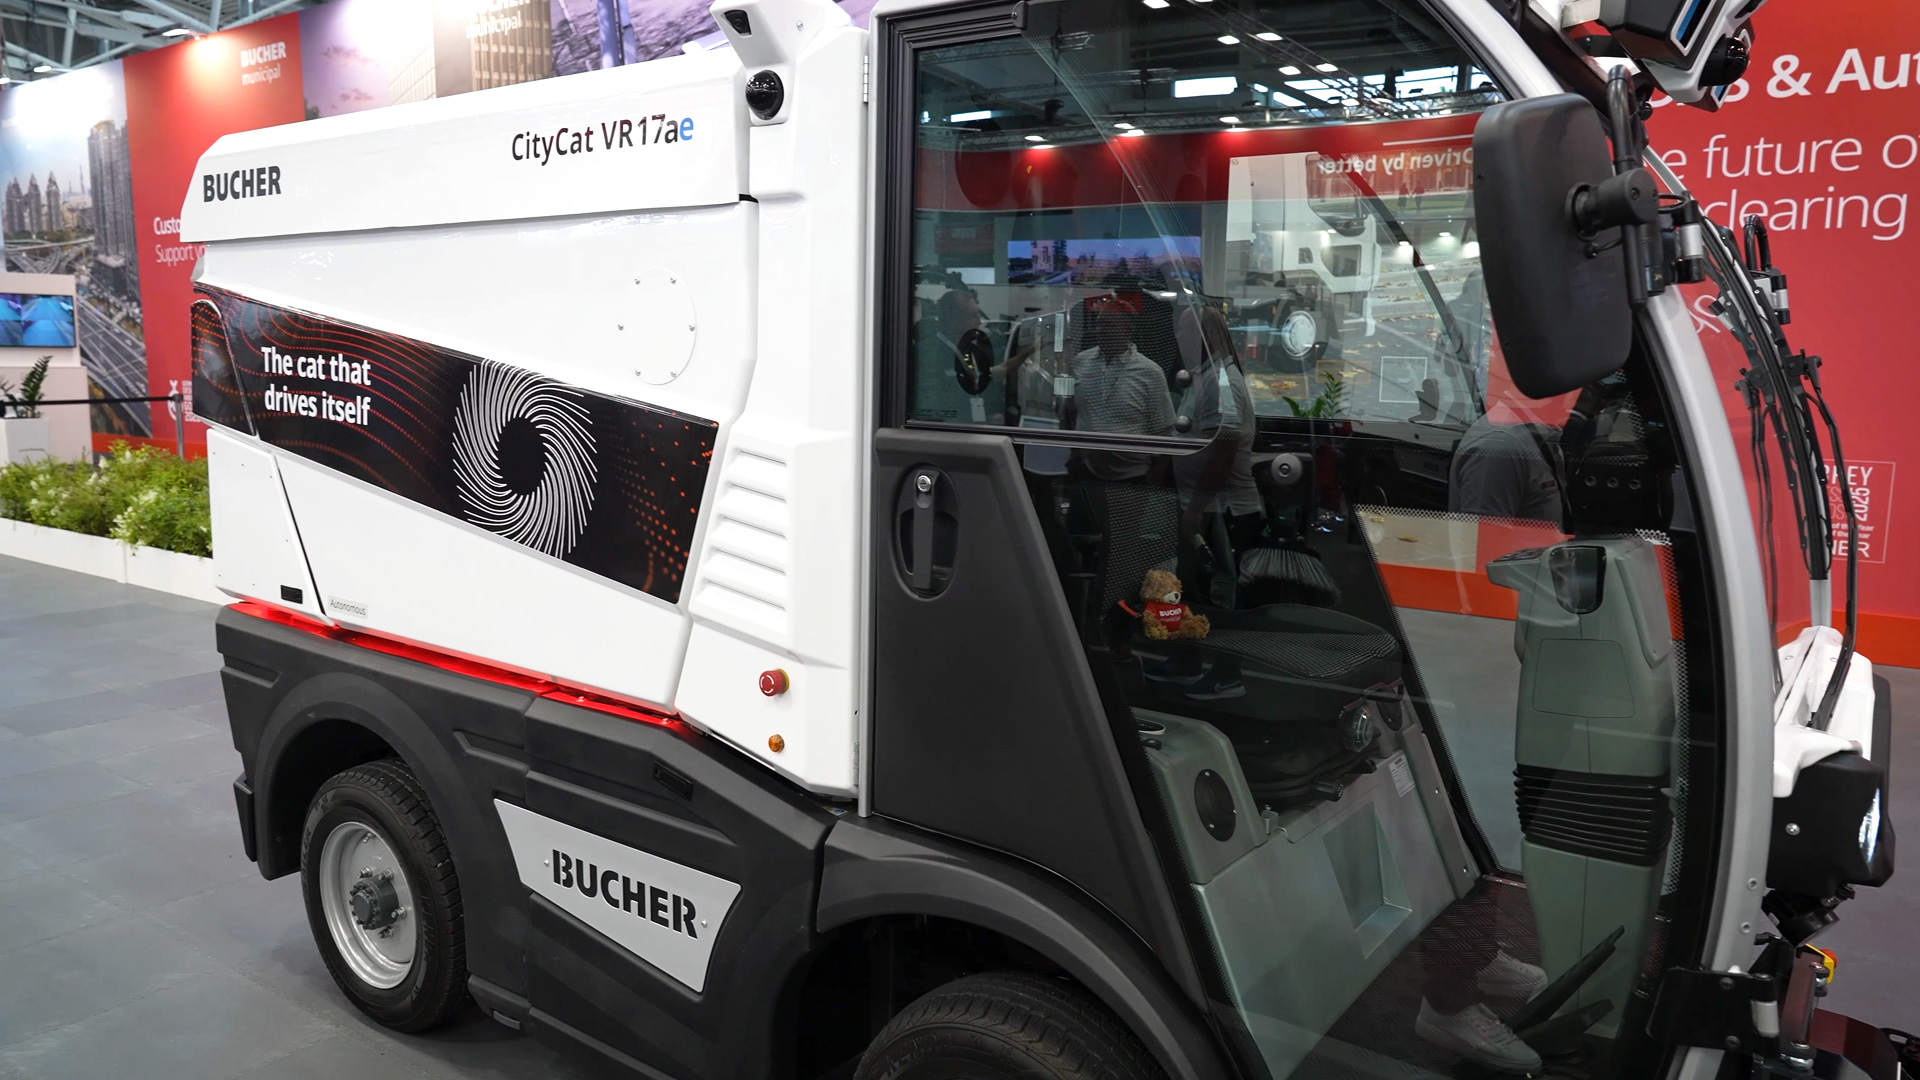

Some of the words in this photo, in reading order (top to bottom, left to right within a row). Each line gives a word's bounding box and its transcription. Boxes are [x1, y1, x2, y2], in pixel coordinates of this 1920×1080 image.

[241, 41, 287, 67] BUCHER
[242, 63, 281, 86] municipal
[1767, 54, 1811, 98] &
[512, 126, 594, 166] CityCat
[601, 113, 694, 150] VR17ae
[1703, 134, 1862, 178] future
[1882, 134, 1920, 168] o
[203, 165, 282, 203] BUCHER
[155, 243, 193, 267] Support
[261, 346, 293, 376] The
[297, 354, 326, 380] cat
[329, 353, 372, 386] that
[264, 383, 317, 418] drives
[322, 391, 372, 426] itself
[330, 599, 366, 615] Autonomous
[552, 848, 699, 941] BUCHER
